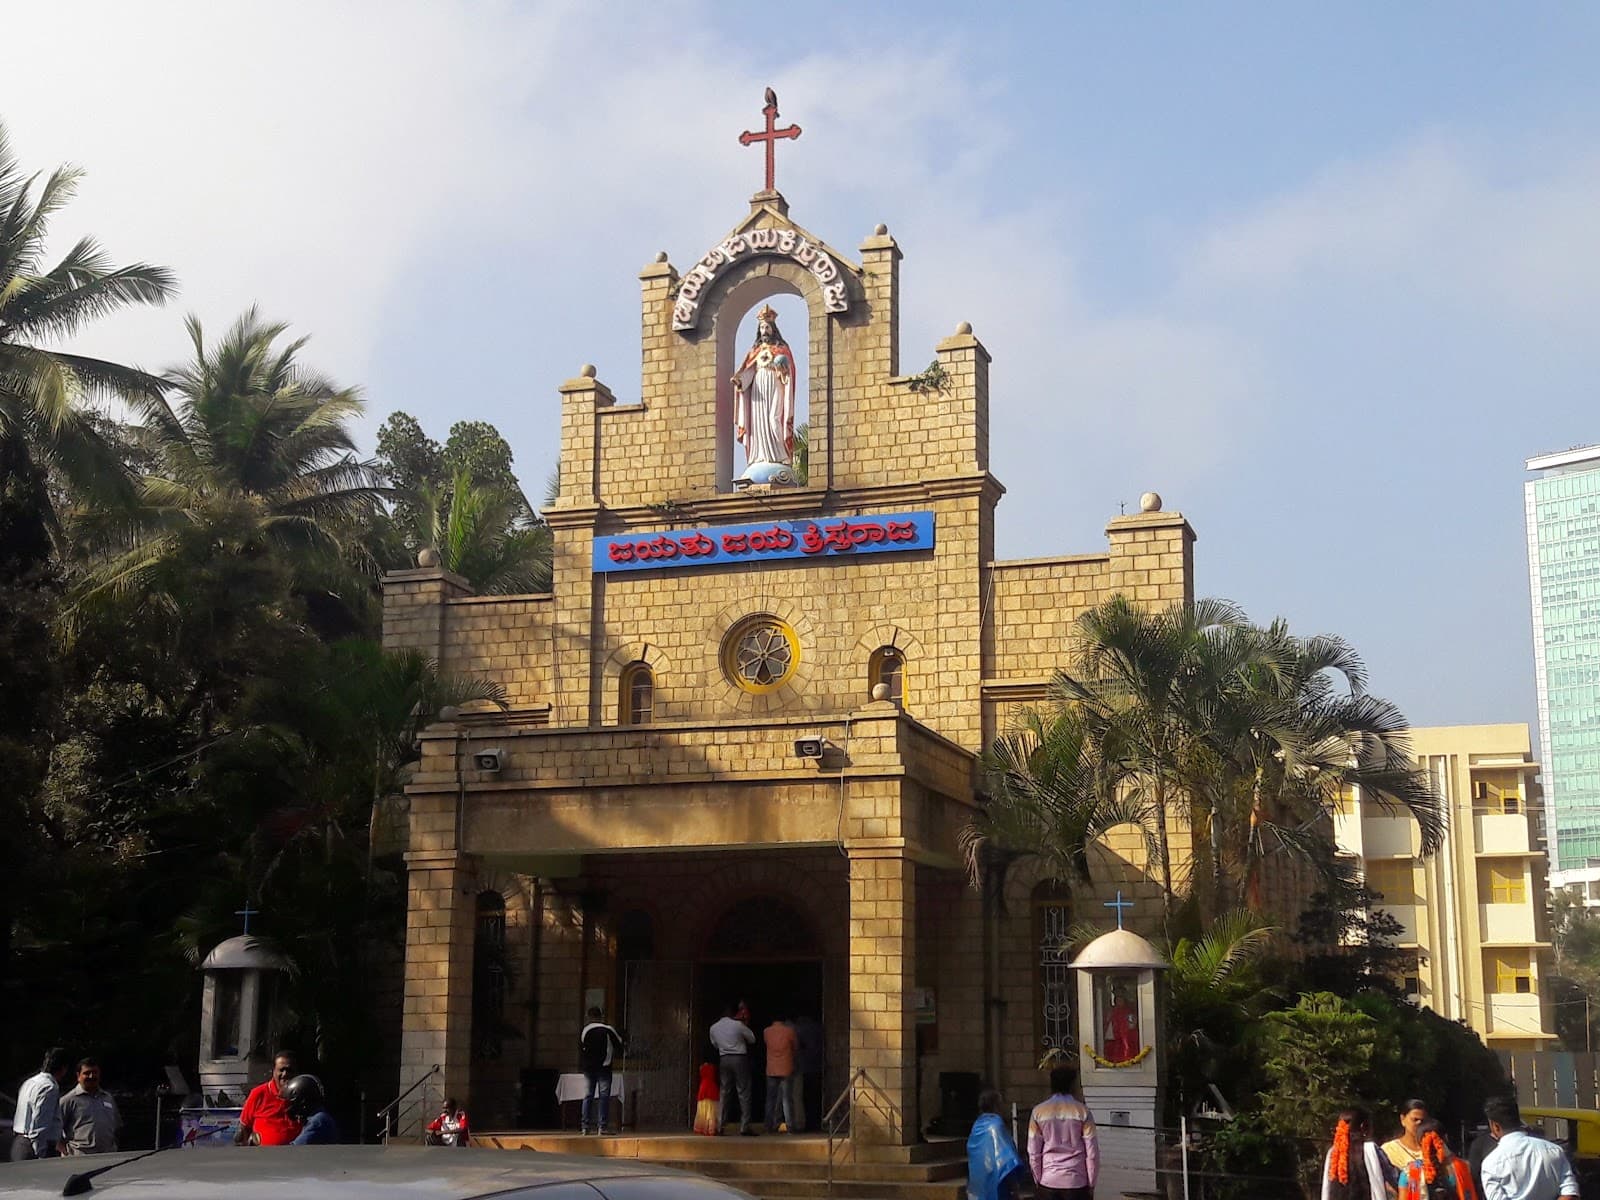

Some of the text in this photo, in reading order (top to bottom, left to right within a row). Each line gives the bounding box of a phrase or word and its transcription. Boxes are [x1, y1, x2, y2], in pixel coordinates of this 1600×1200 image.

[608, 520, 913, 561] ಜಯತು ಜಯ ಕ್ರಿಸ್ತರಾಜ
